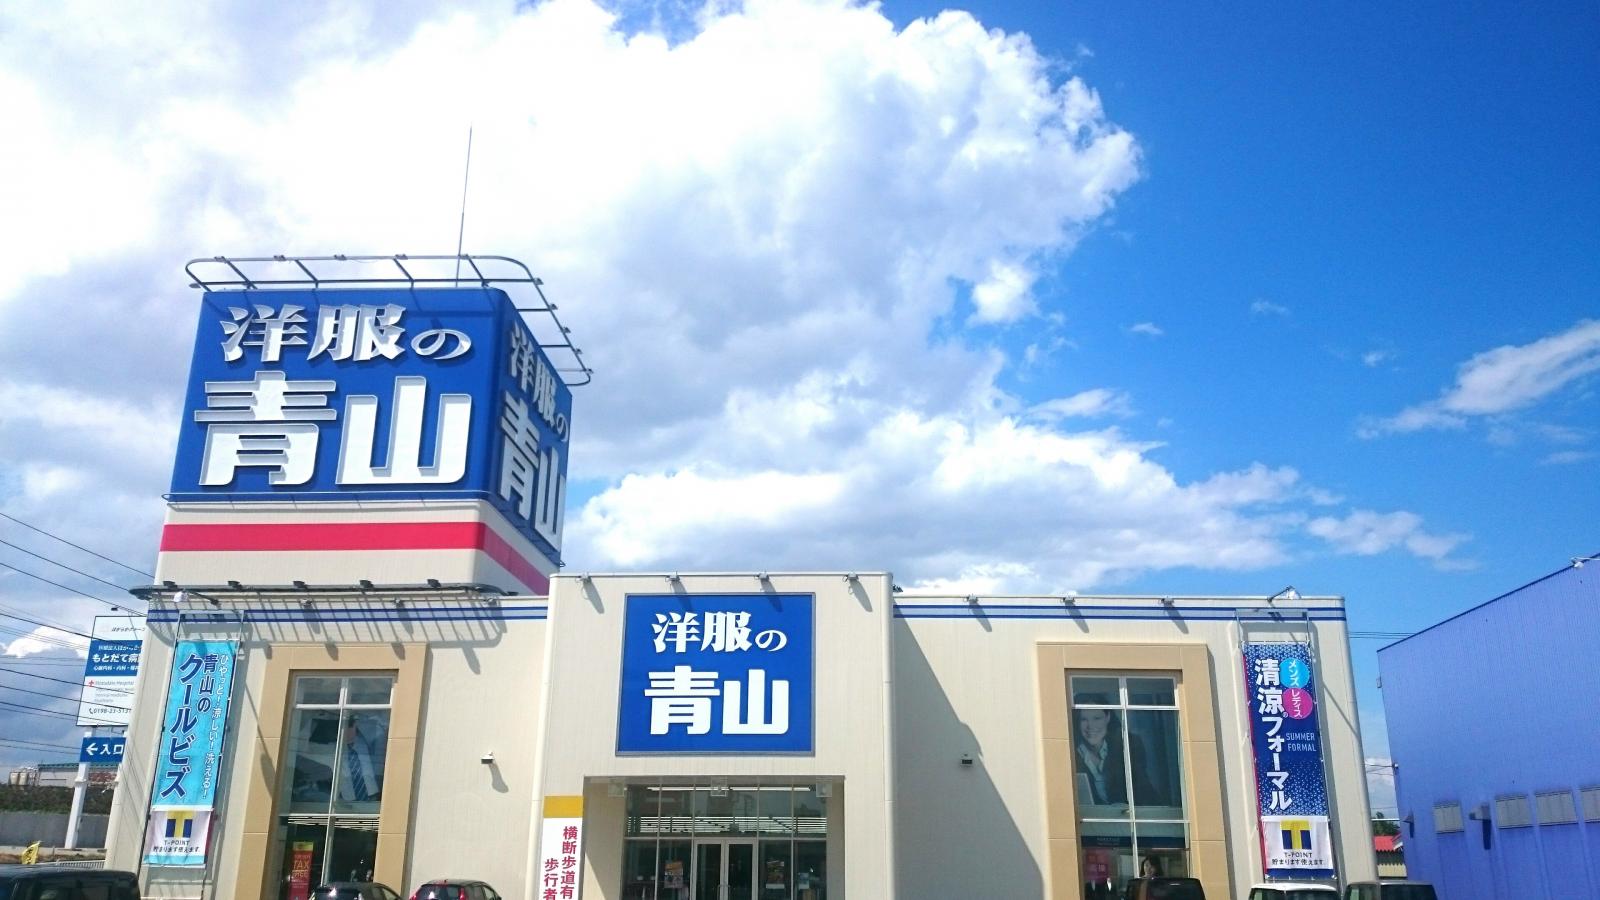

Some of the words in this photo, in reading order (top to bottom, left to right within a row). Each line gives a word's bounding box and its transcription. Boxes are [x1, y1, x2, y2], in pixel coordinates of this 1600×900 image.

[219, 303, 474, 362] 洋服の
[511, 319, 569, 442] 洋服の
[194, 370, 472, 486] 青山
[500, 390, 566, 552] 青山
[651, 610, 788, 653] 洋服の
[197, 654, 218, 712] 青山の
[1288, 659, 1299, 686] メンズ
[644, 665, 790, 735] 青山
[1291, 689, 1303, 718] レディス
[160, 654, 203, 798] クールビズ
[1285, 732, 1315, 741] SUMMER
[1288, 743, 1317, 752] FORMAL
[100, 744, 124, 755] 入口
[294, 860, 310, 870] TAX
[543, 858, 559, 900] 歩行者
[560, 826, 578, 899] 横断歩道有
[1271, 858, 1324, 866] 貯まります使えます
